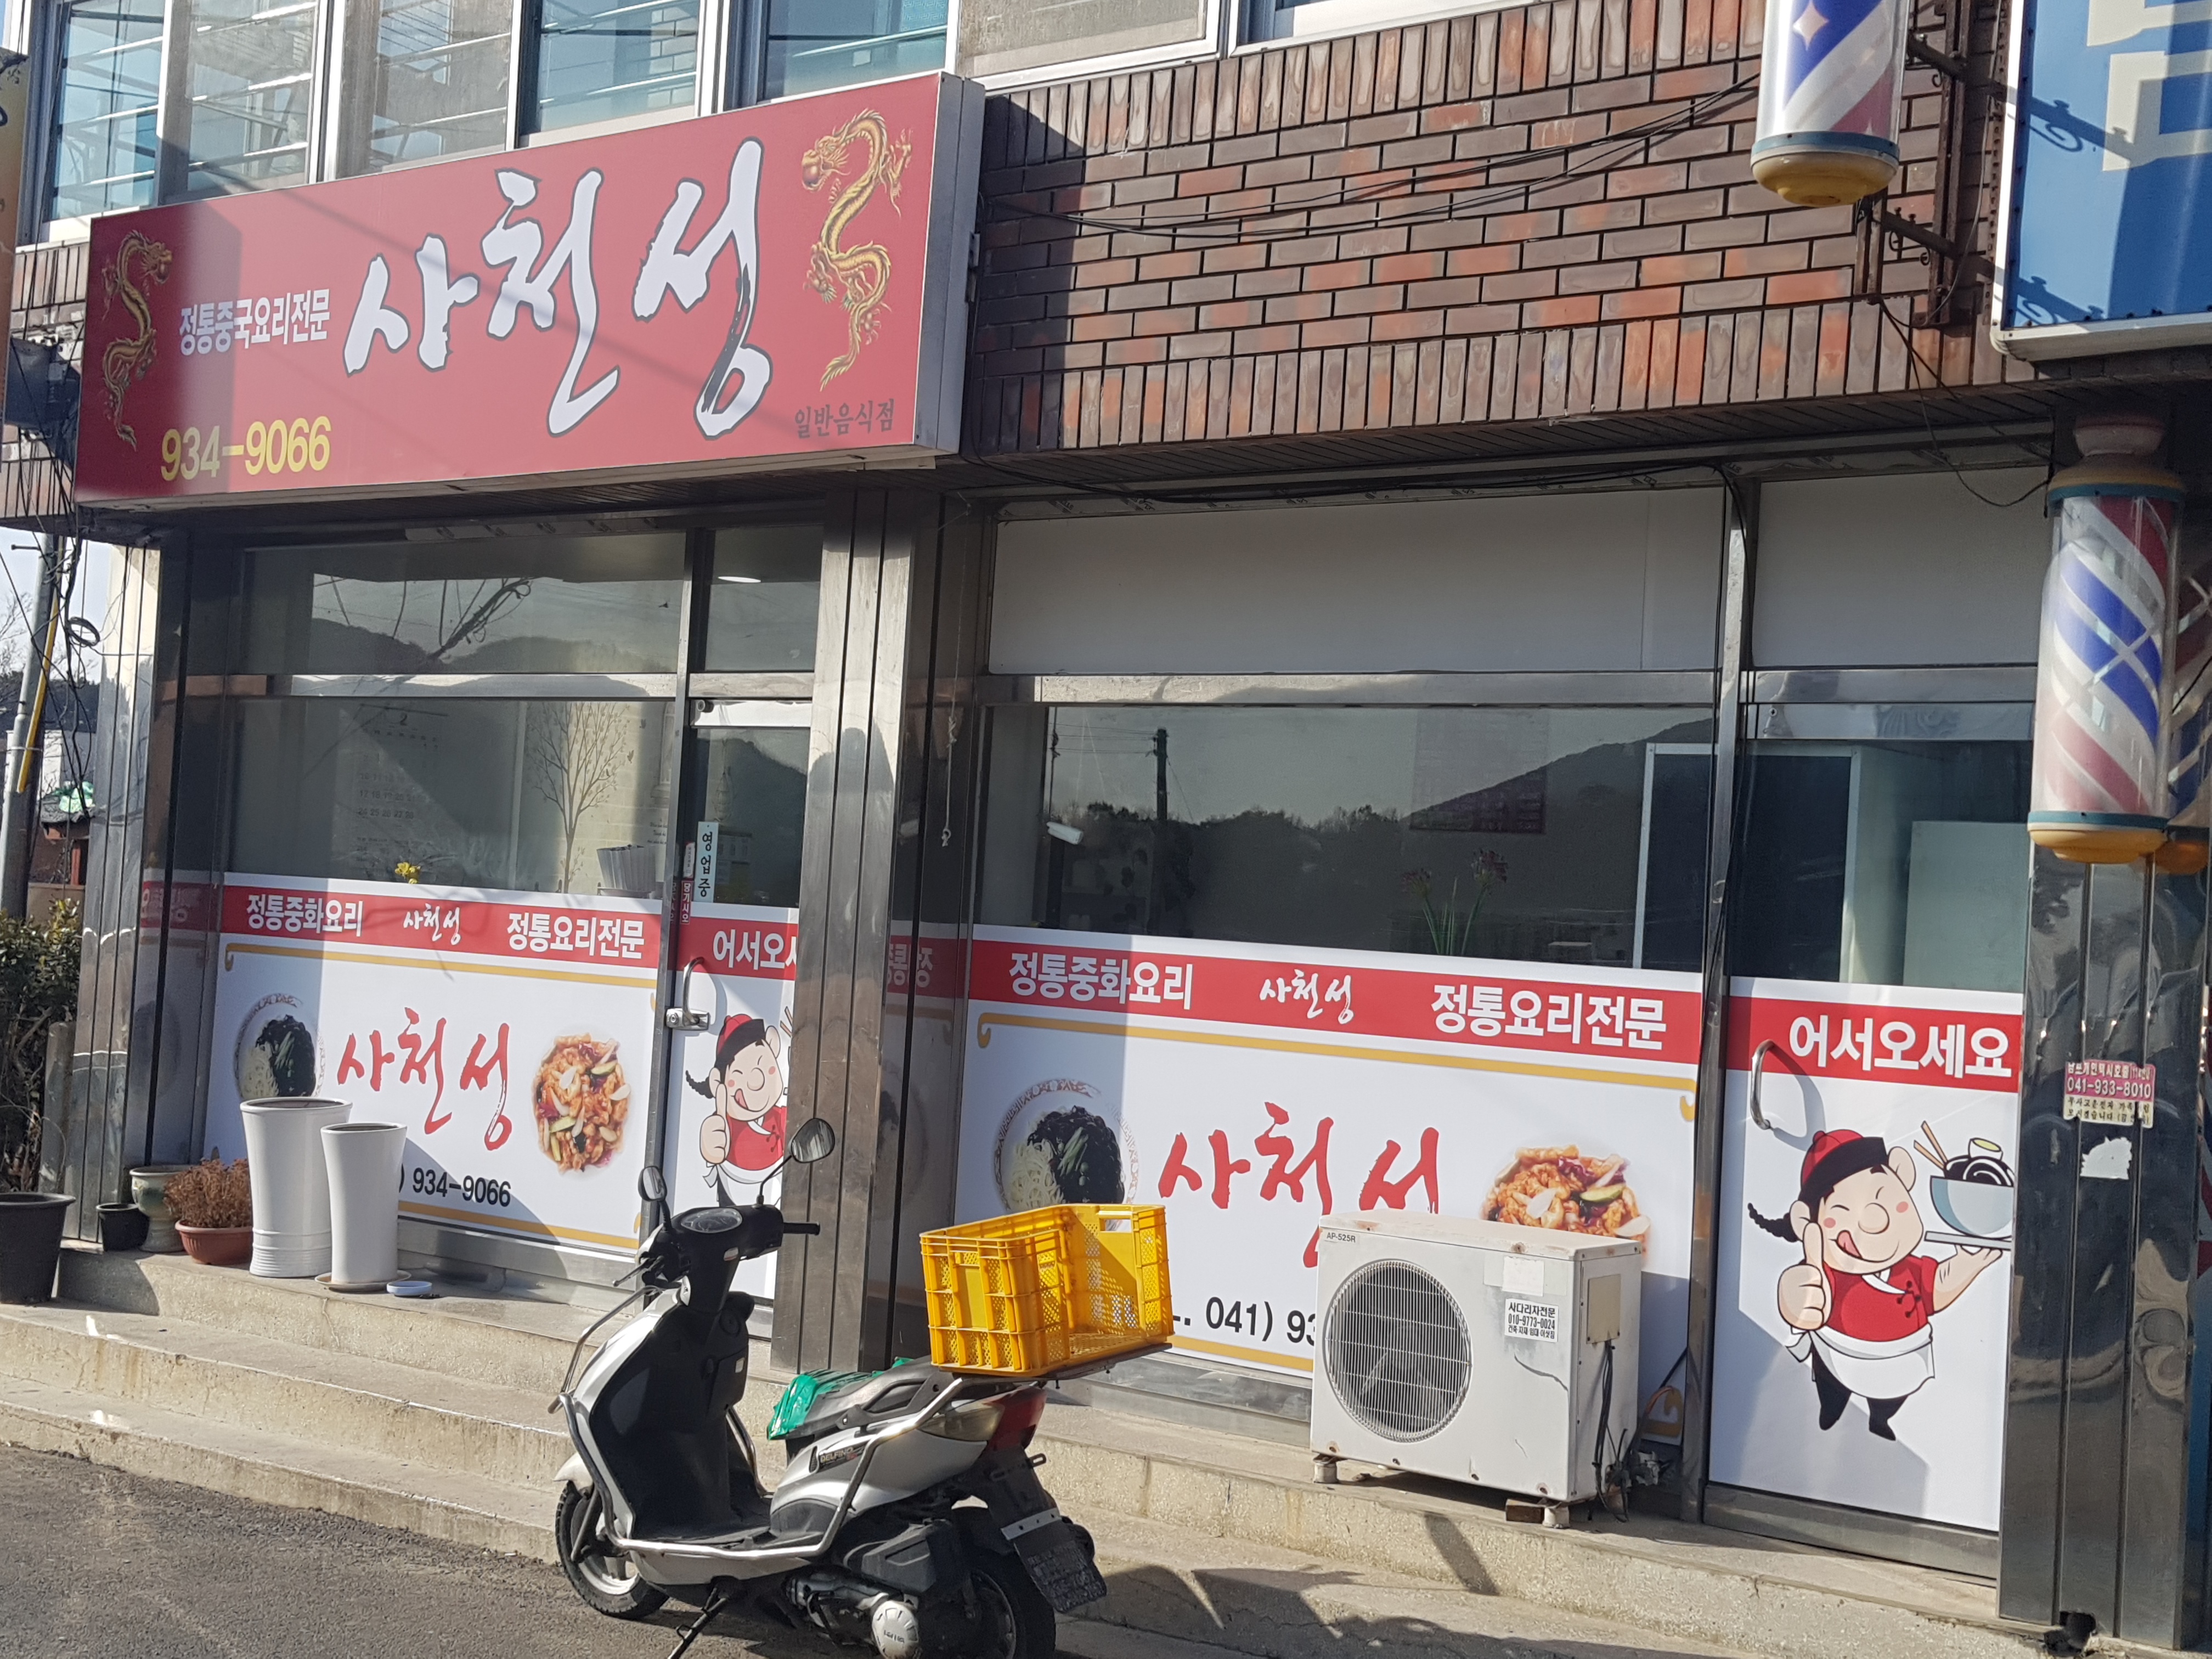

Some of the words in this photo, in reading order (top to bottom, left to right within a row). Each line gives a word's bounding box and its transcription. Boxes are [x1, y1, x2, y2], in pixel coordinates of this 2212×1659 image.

[343, 137, 772, 439] 사천성
[179, 289, 331, 357] 정통중국요리전문
[795, 398, 895, 439] 일반음식점
[161, 416, 332, 482] 934-9066
[697, 832, 713, 898] 영업중
[246, 894, 364, 936] 정통중화요리
[403, 902, 461, 946] 사천성
[682, 883, 691, 923] 당기시오
[506, 912, 646, 960] 정통요리전문
[1009, 952, 1194, 1011] 정통중화요리
[1259, 969, 1355, 1025] 사천성
[1431, 984, 1667, 1051] 정통요리전문
[1788, 1015, 2012, 1079] 어서오세요
[337, 1007, 512, 1151] 사천성
[2067, 1076, 2152, 1098] 041-933-8010
[413, 1167, 511, 1207] 934-9066
[1326, 1232, 1356, 1244] AP-525R
[1206, 1296, 1273, 1342] 041)
[1508, 1313, 1555, 1330] 010-9773-0024
[820, 1447, 854, 1463] DELFINO
